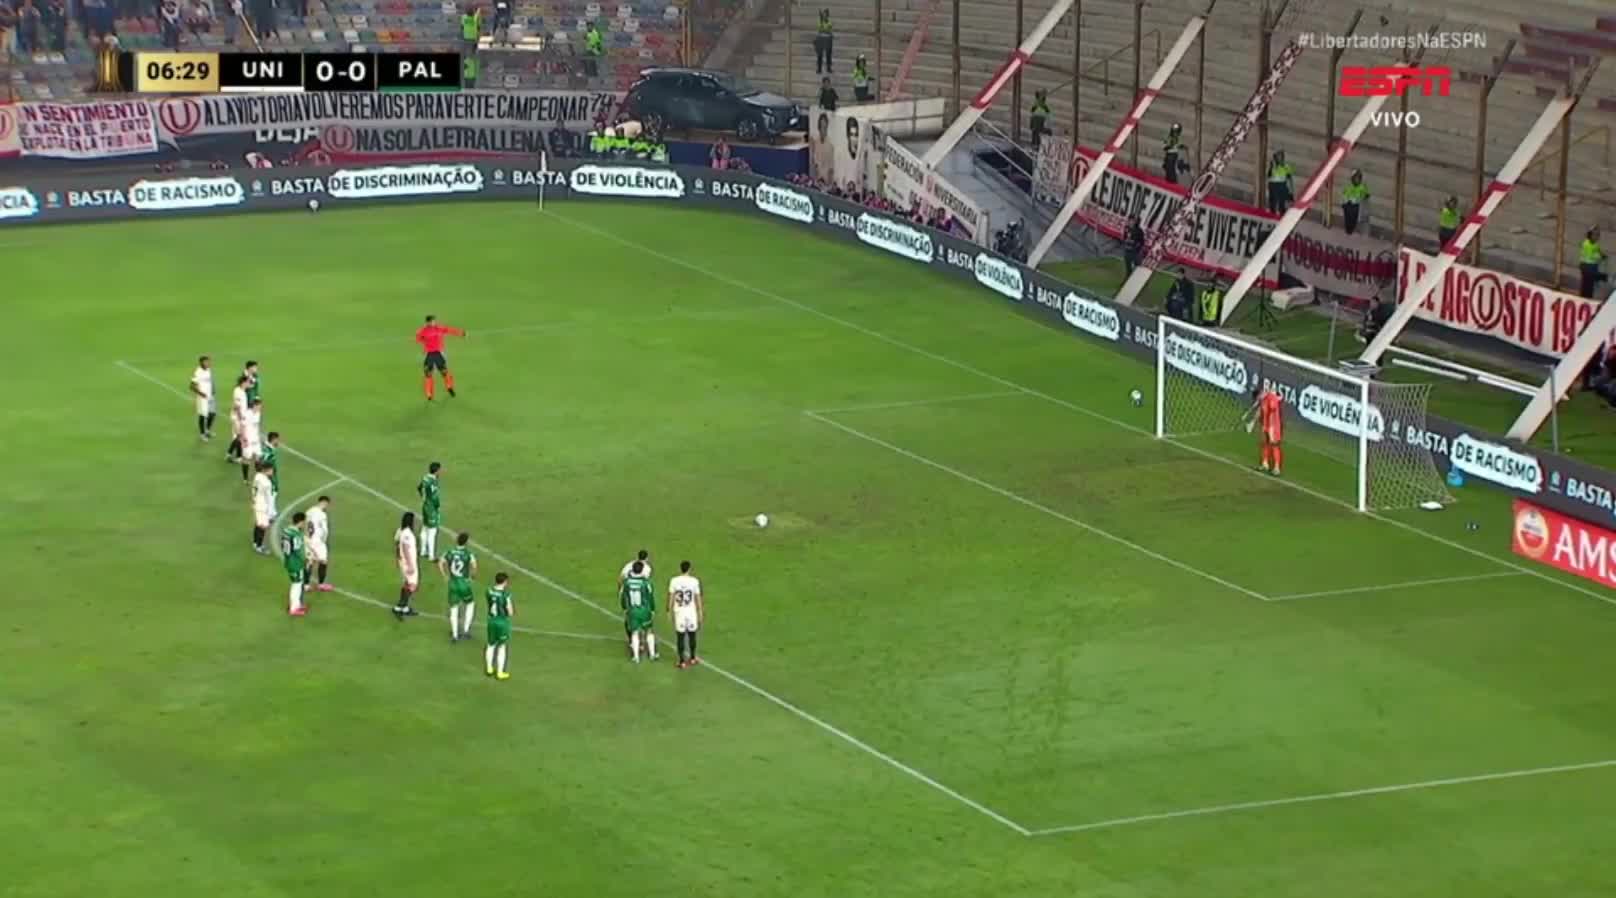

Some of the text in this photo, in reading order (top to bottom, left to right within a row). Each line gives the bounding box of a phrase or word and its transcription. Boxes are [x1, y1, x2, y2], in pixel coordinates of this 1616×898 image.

[38, 102, 147, 123] SENTIMIENTO
[497, 95, 588, 121] CAMPEONAR
[101, 117, 150, 132] PERTO
[100, 132, 152, 148] TRIBNA
[272, 169, 476, 195] BASTA DE DISCRIMINAÇÃO
[512, 170, 678, 190] BASTA DE VIOLÊNCIA
[69, 183, 236, 206] BASTA DE RACISMO
[712, 181, 810, 216] BASTA DE RACISMO
[828, 208, 856, 229] BASTA
[947, 248, 974, 270] BASTA
[1037, 287, 1118, 332] BASTA DE RACISMO
[1303, 393, 1318, 413] DE
[1320, 402, 1380, 434] VIOLÊNIA
[1406, 425, 1537, 483] BASTA DE RACISMO
[1567, 478, 1612, 510] BASTA
[675, 589, 692, 606] 33
